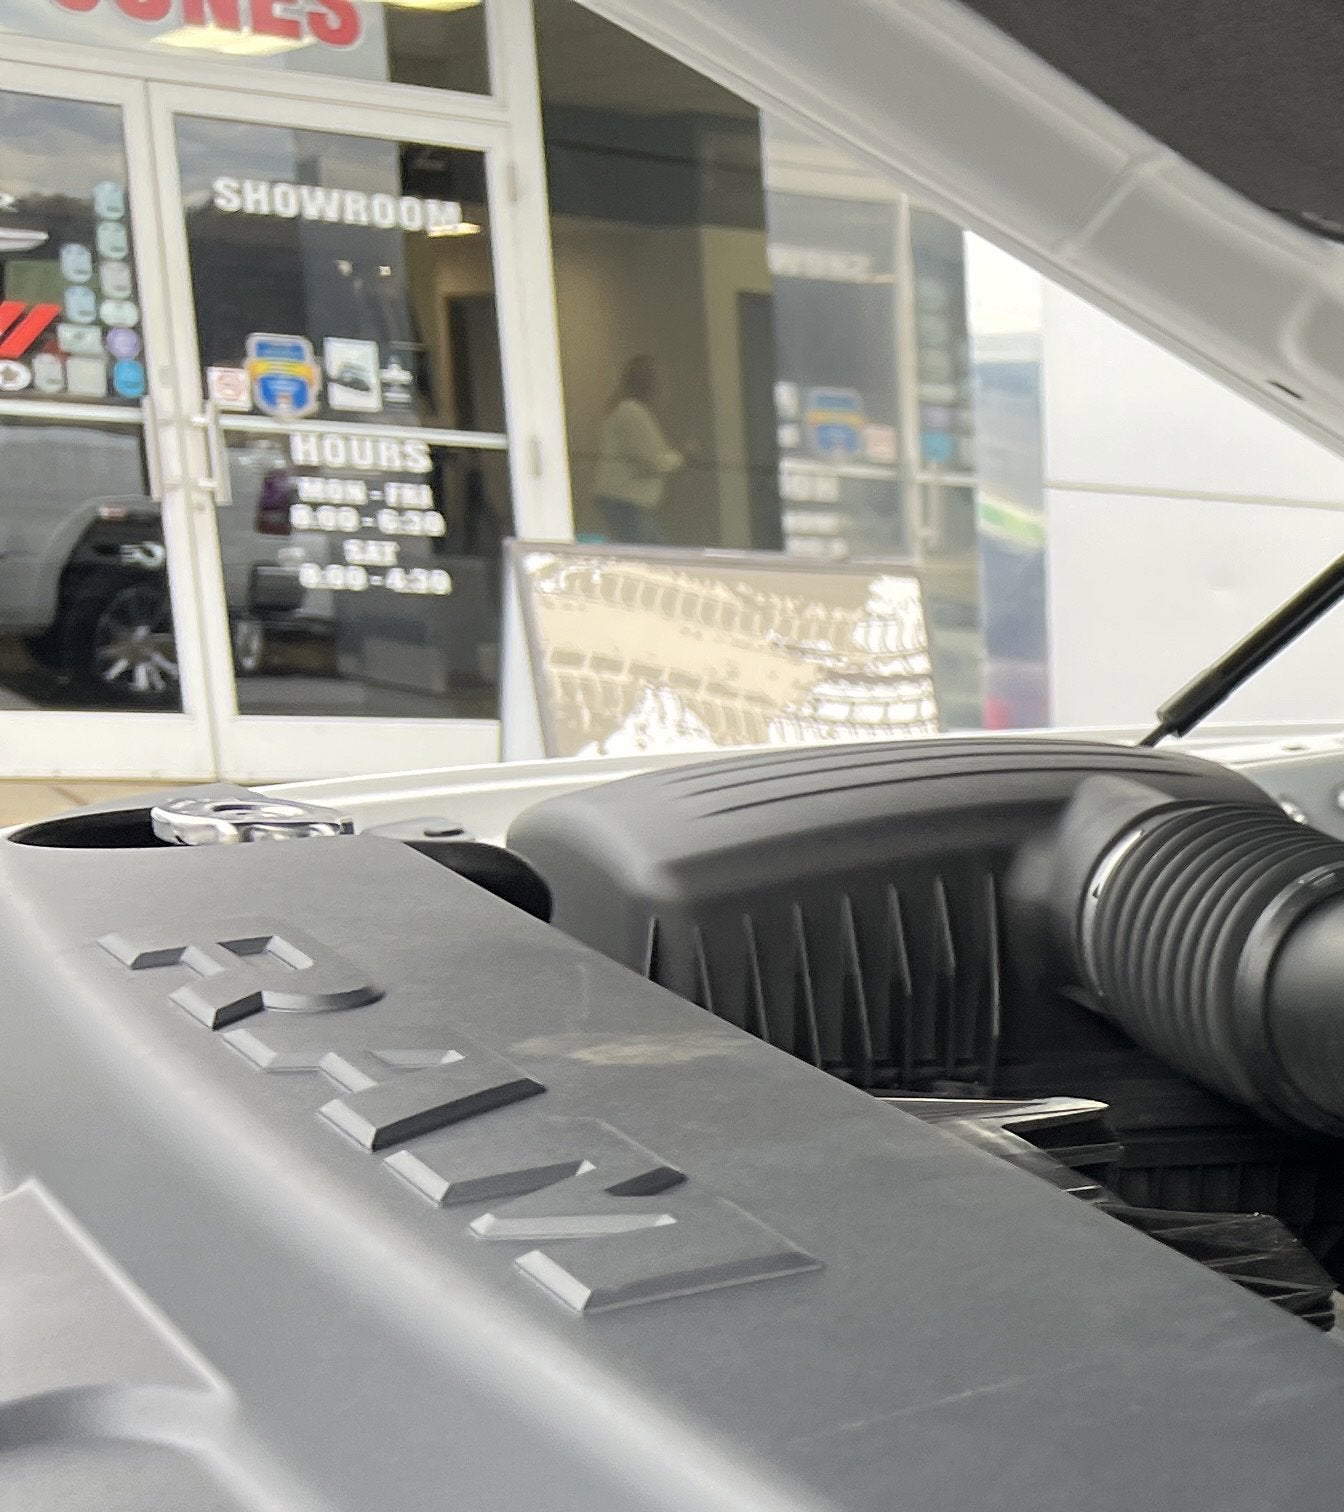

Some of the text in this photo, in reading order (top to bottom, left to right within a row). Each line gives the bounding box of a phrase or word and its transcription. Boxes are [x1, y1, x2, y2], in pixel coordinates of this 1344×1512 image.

[213, 176, 462, 234] SHOWROOM
[290, 432, 433, 473] HOURS
[97, 920, 826, 1315] RAM
